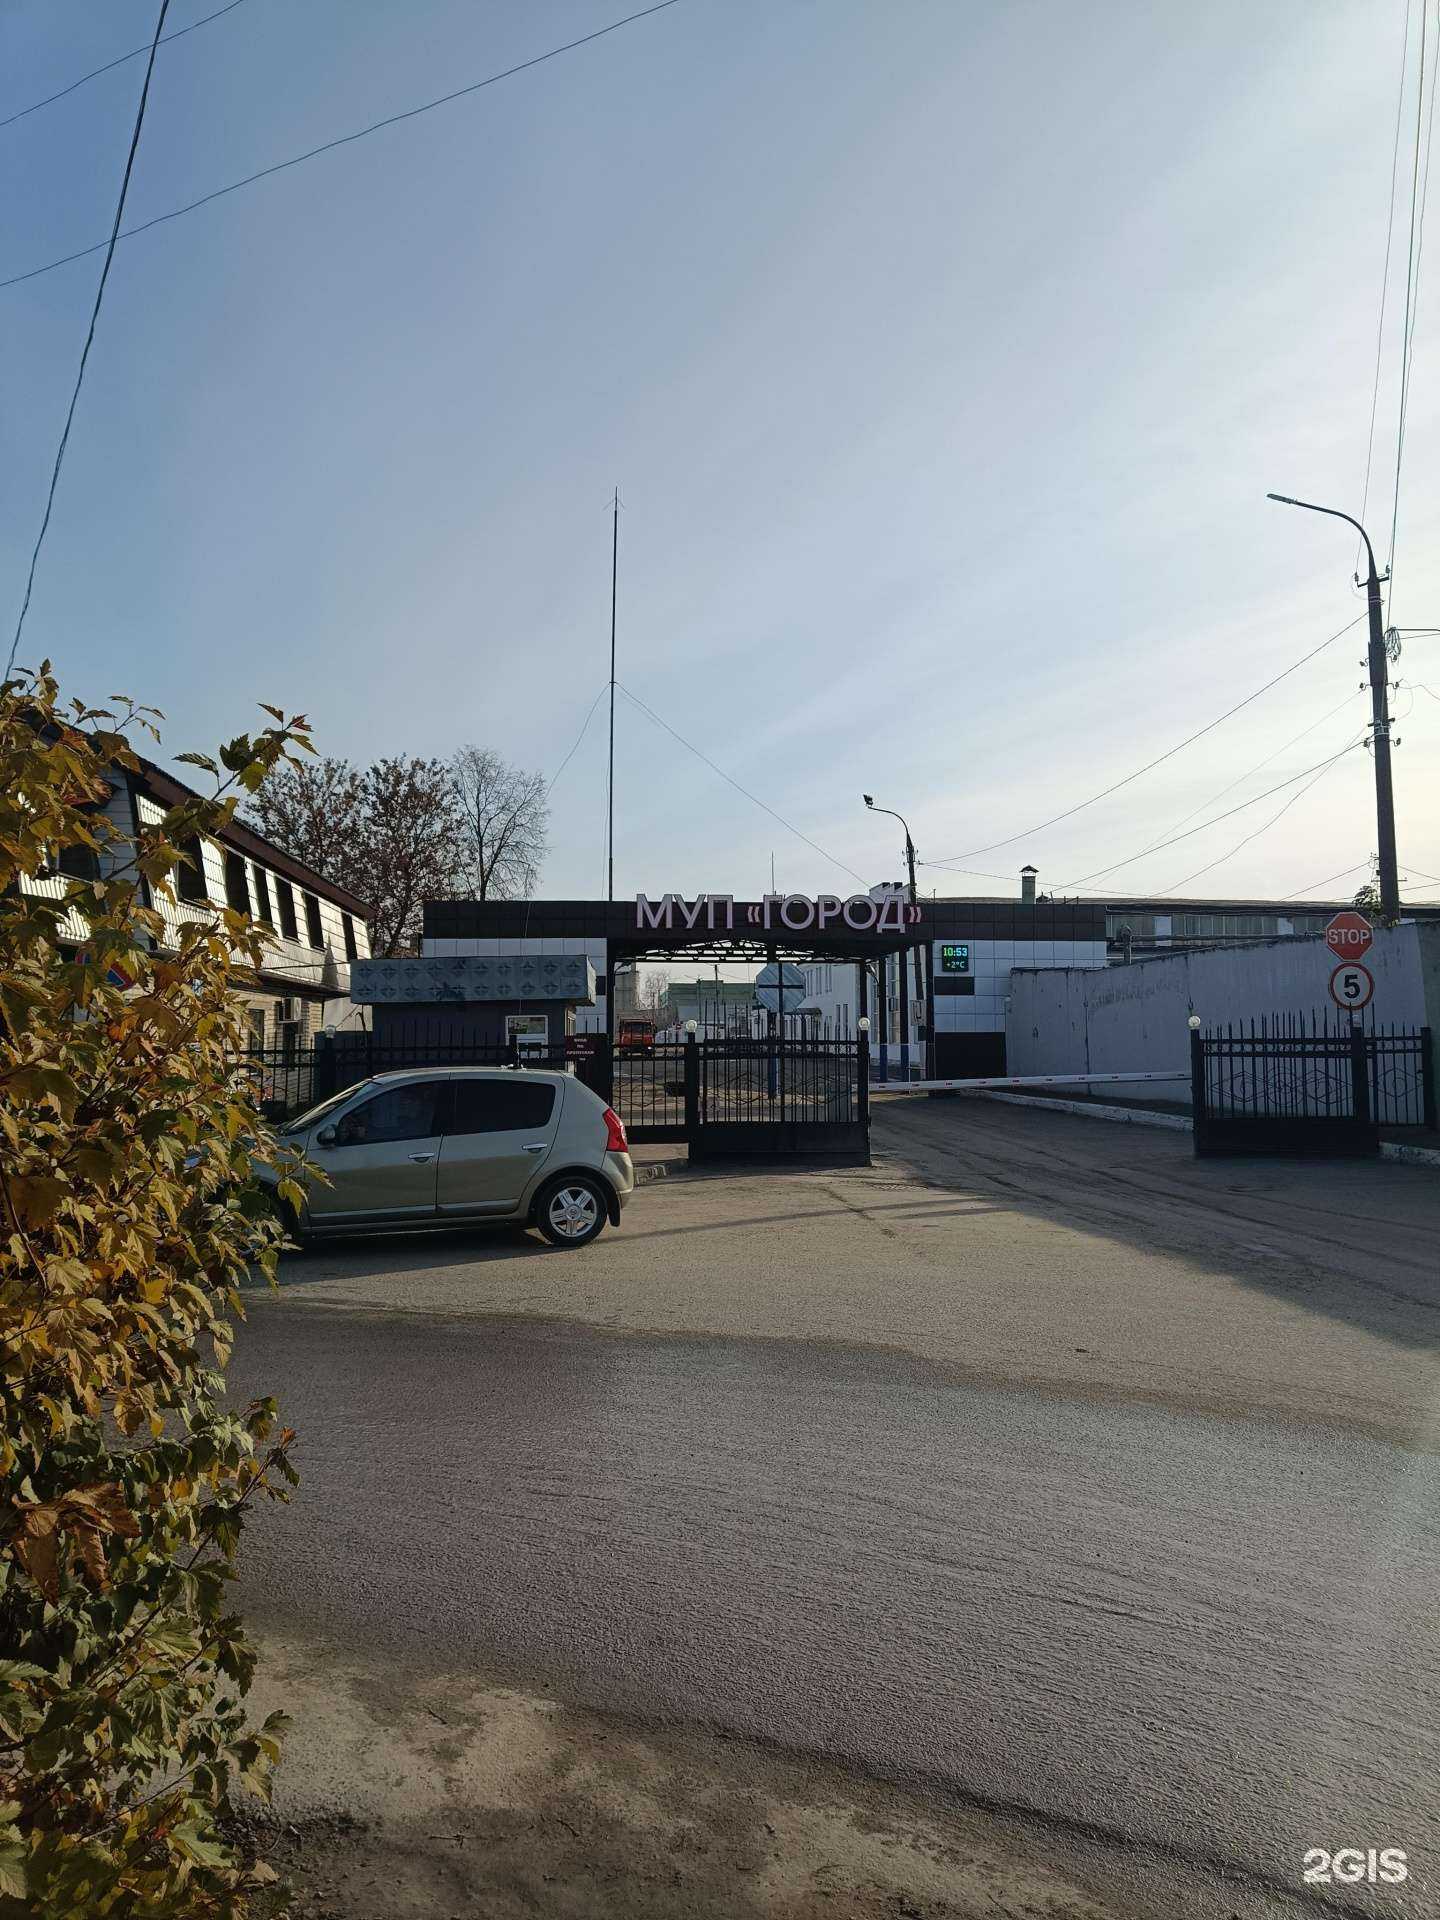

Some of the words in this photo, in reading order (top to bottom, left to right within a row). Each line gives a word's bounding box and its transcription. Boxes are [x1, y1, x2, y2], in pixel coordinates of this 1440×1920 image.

[636, 894, 733, 929] МУП
[747, 894, 922, 933] «ГОРОД»
[1328, 929, 1369, 944] STOP
[943, 947, 968, 956] 10:53
[1344, 974, 1360, 998] 5
